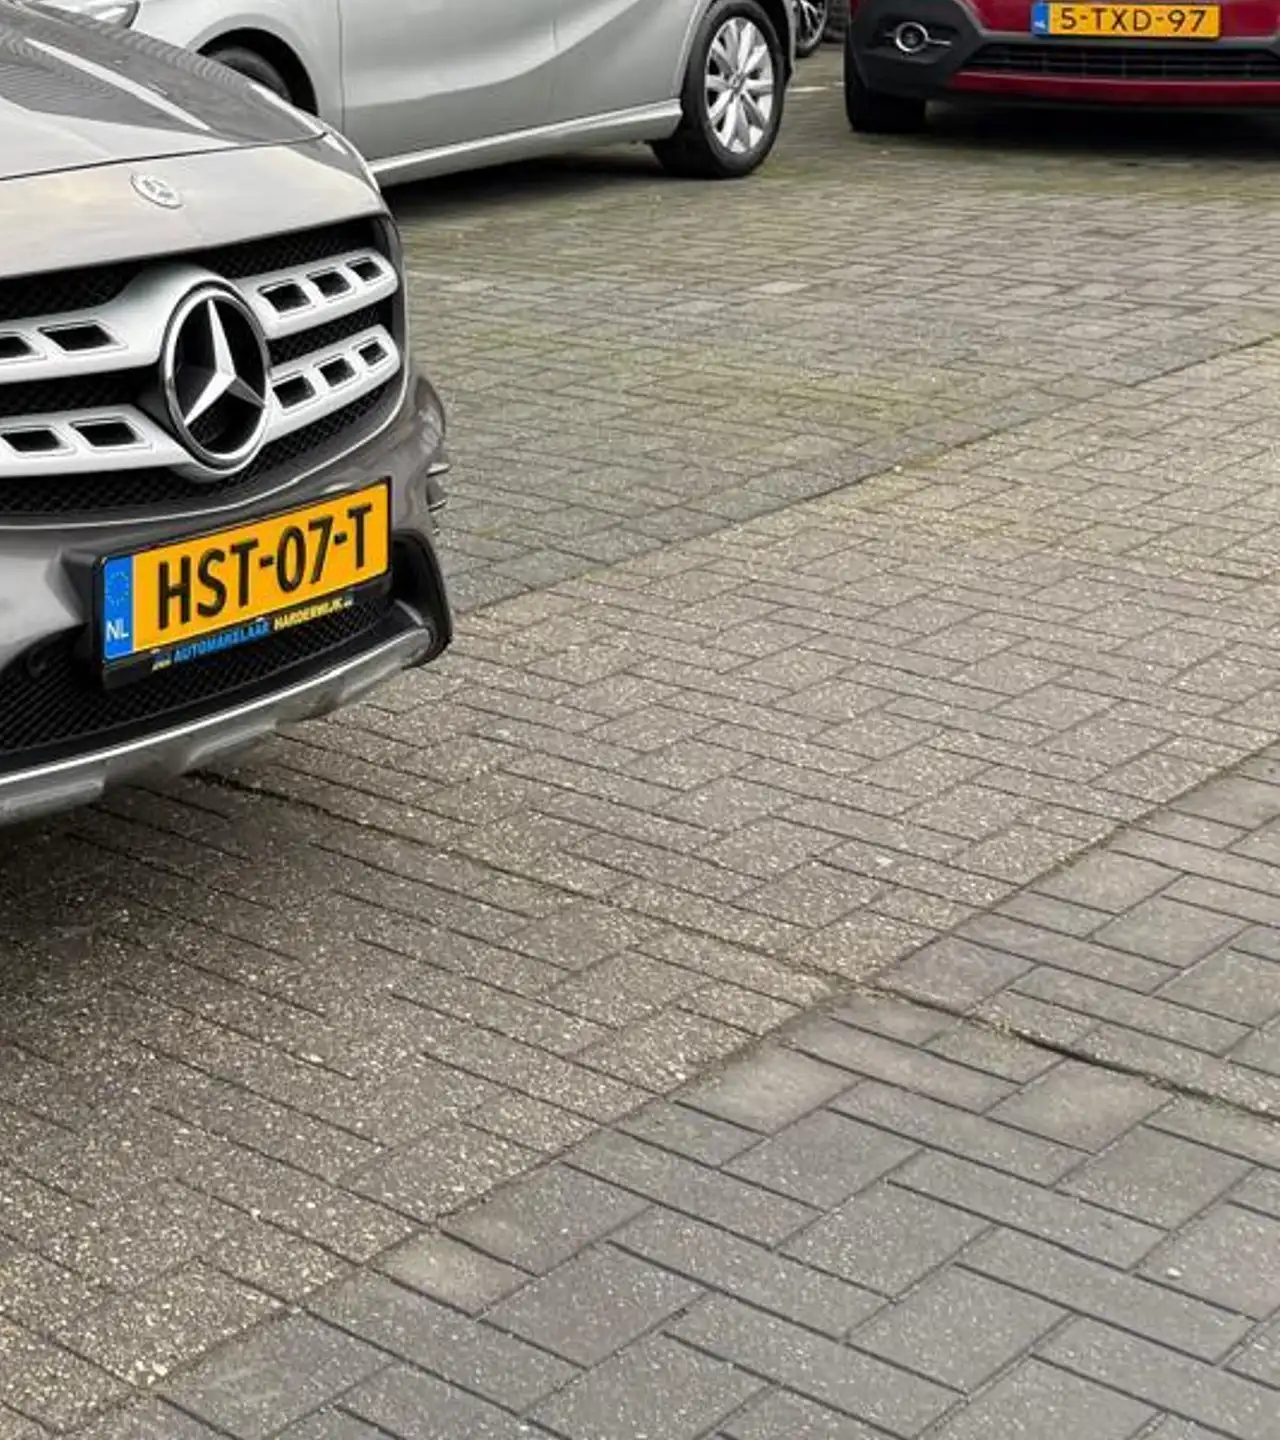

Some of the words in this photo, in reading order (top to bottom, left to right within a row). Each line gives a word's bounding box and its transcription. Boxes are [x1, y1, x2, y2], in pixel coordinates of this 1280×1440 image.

[1061, 7, 1207, 32] 5-TXD-97
[157, 503, 372, 630] HST-07-T
[105, 618, 130, 641] NL
